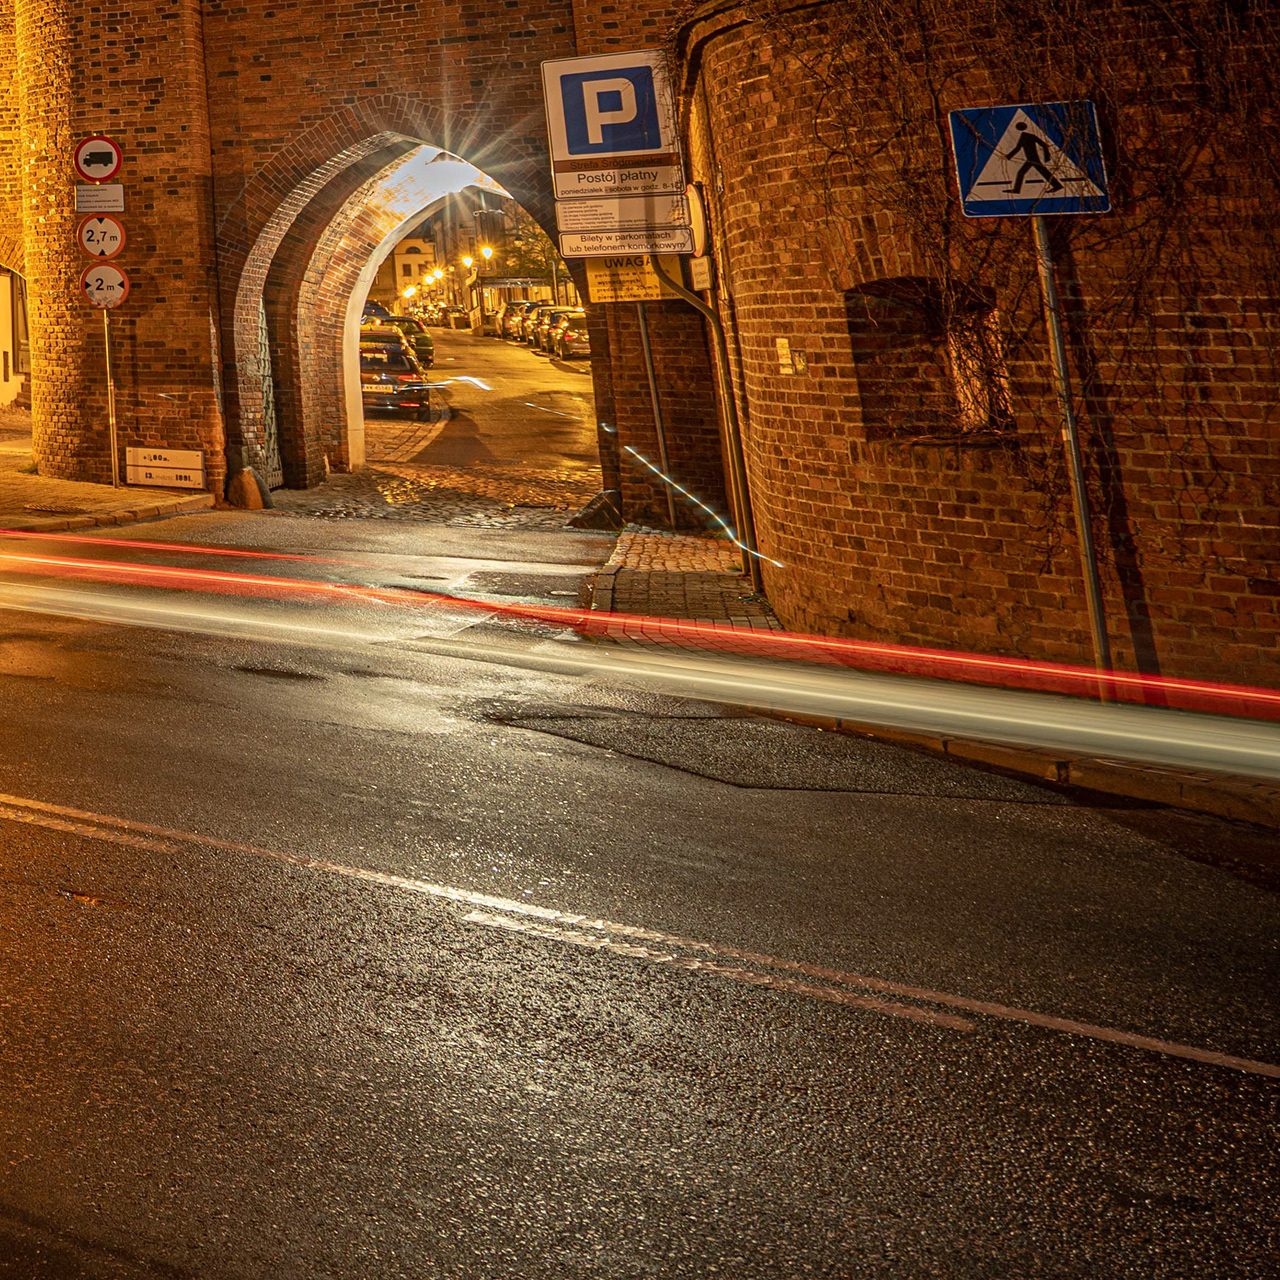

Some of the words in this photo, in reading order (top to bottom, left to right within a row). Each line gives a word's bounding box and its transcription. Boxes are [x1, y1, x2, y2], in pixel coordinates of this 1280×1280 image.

[582, 77, 638, 145] P
[570, 160, 599, 170] Strefa
[577, 171, 616, 185] Postój
[620, 170, 658, 183] płatny
[560, 187, 603, 196] poniedziałek
[609, 185, 632, 193] sobota
[86, 229, 107, 245] 2,7
[109, 234, 118, 242] m
[580, 234, 604, 244] Bilety
[615, 231, 671, 242] parkomatach
[569, 245, 582, 253] lub
[584, 243, 626, 252] telefonem
[627, 240, 686, 251] komórkowym
[95, 277, 105, 291] 2
[106, 283, 115, 291] m
